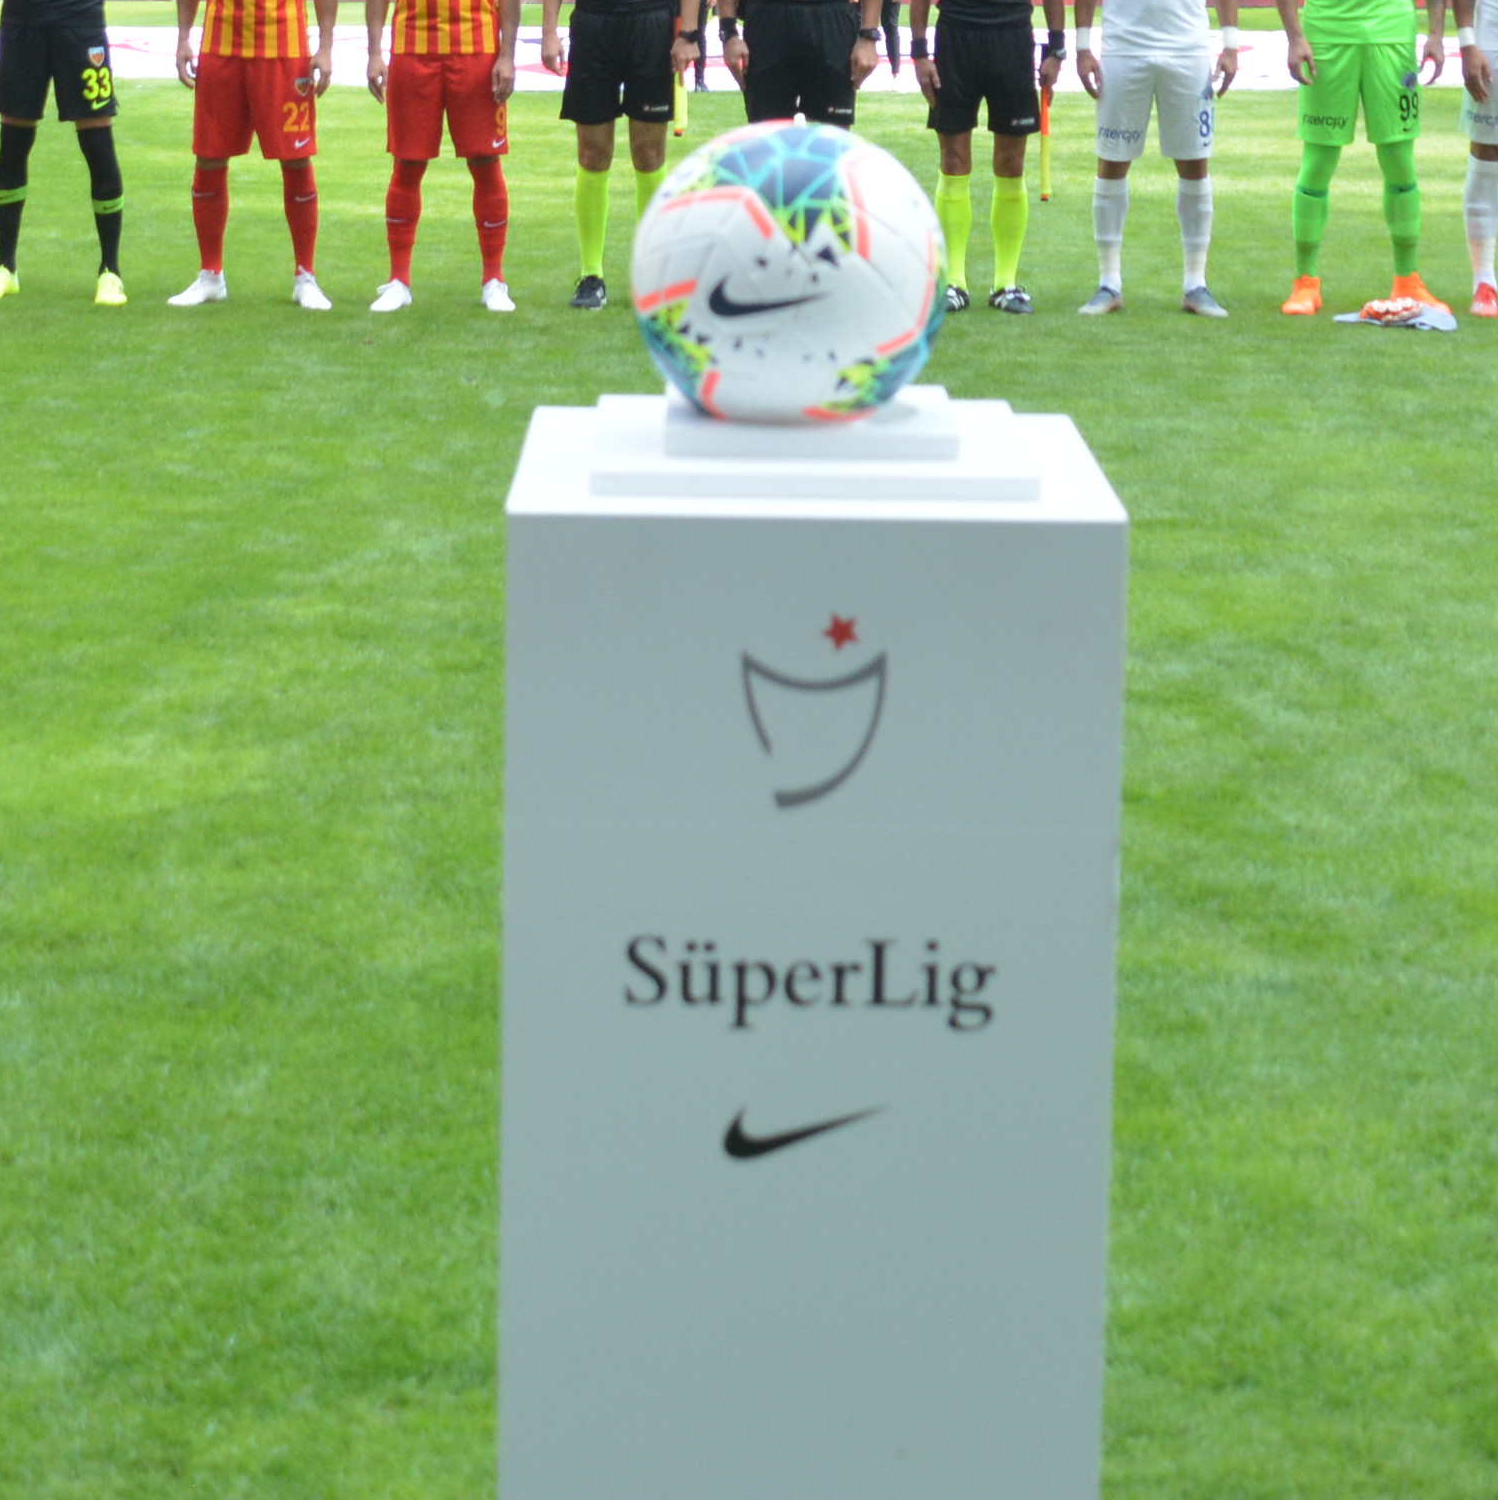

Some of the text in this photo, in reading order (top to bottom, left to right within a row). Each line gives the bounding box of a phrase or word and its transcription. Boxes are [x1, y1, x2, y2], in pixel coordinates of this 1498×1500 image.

[82, 66, 112, 101] 33
[282, 101, 311, 133] 22
[1399, 91, 1419, 122] 99
